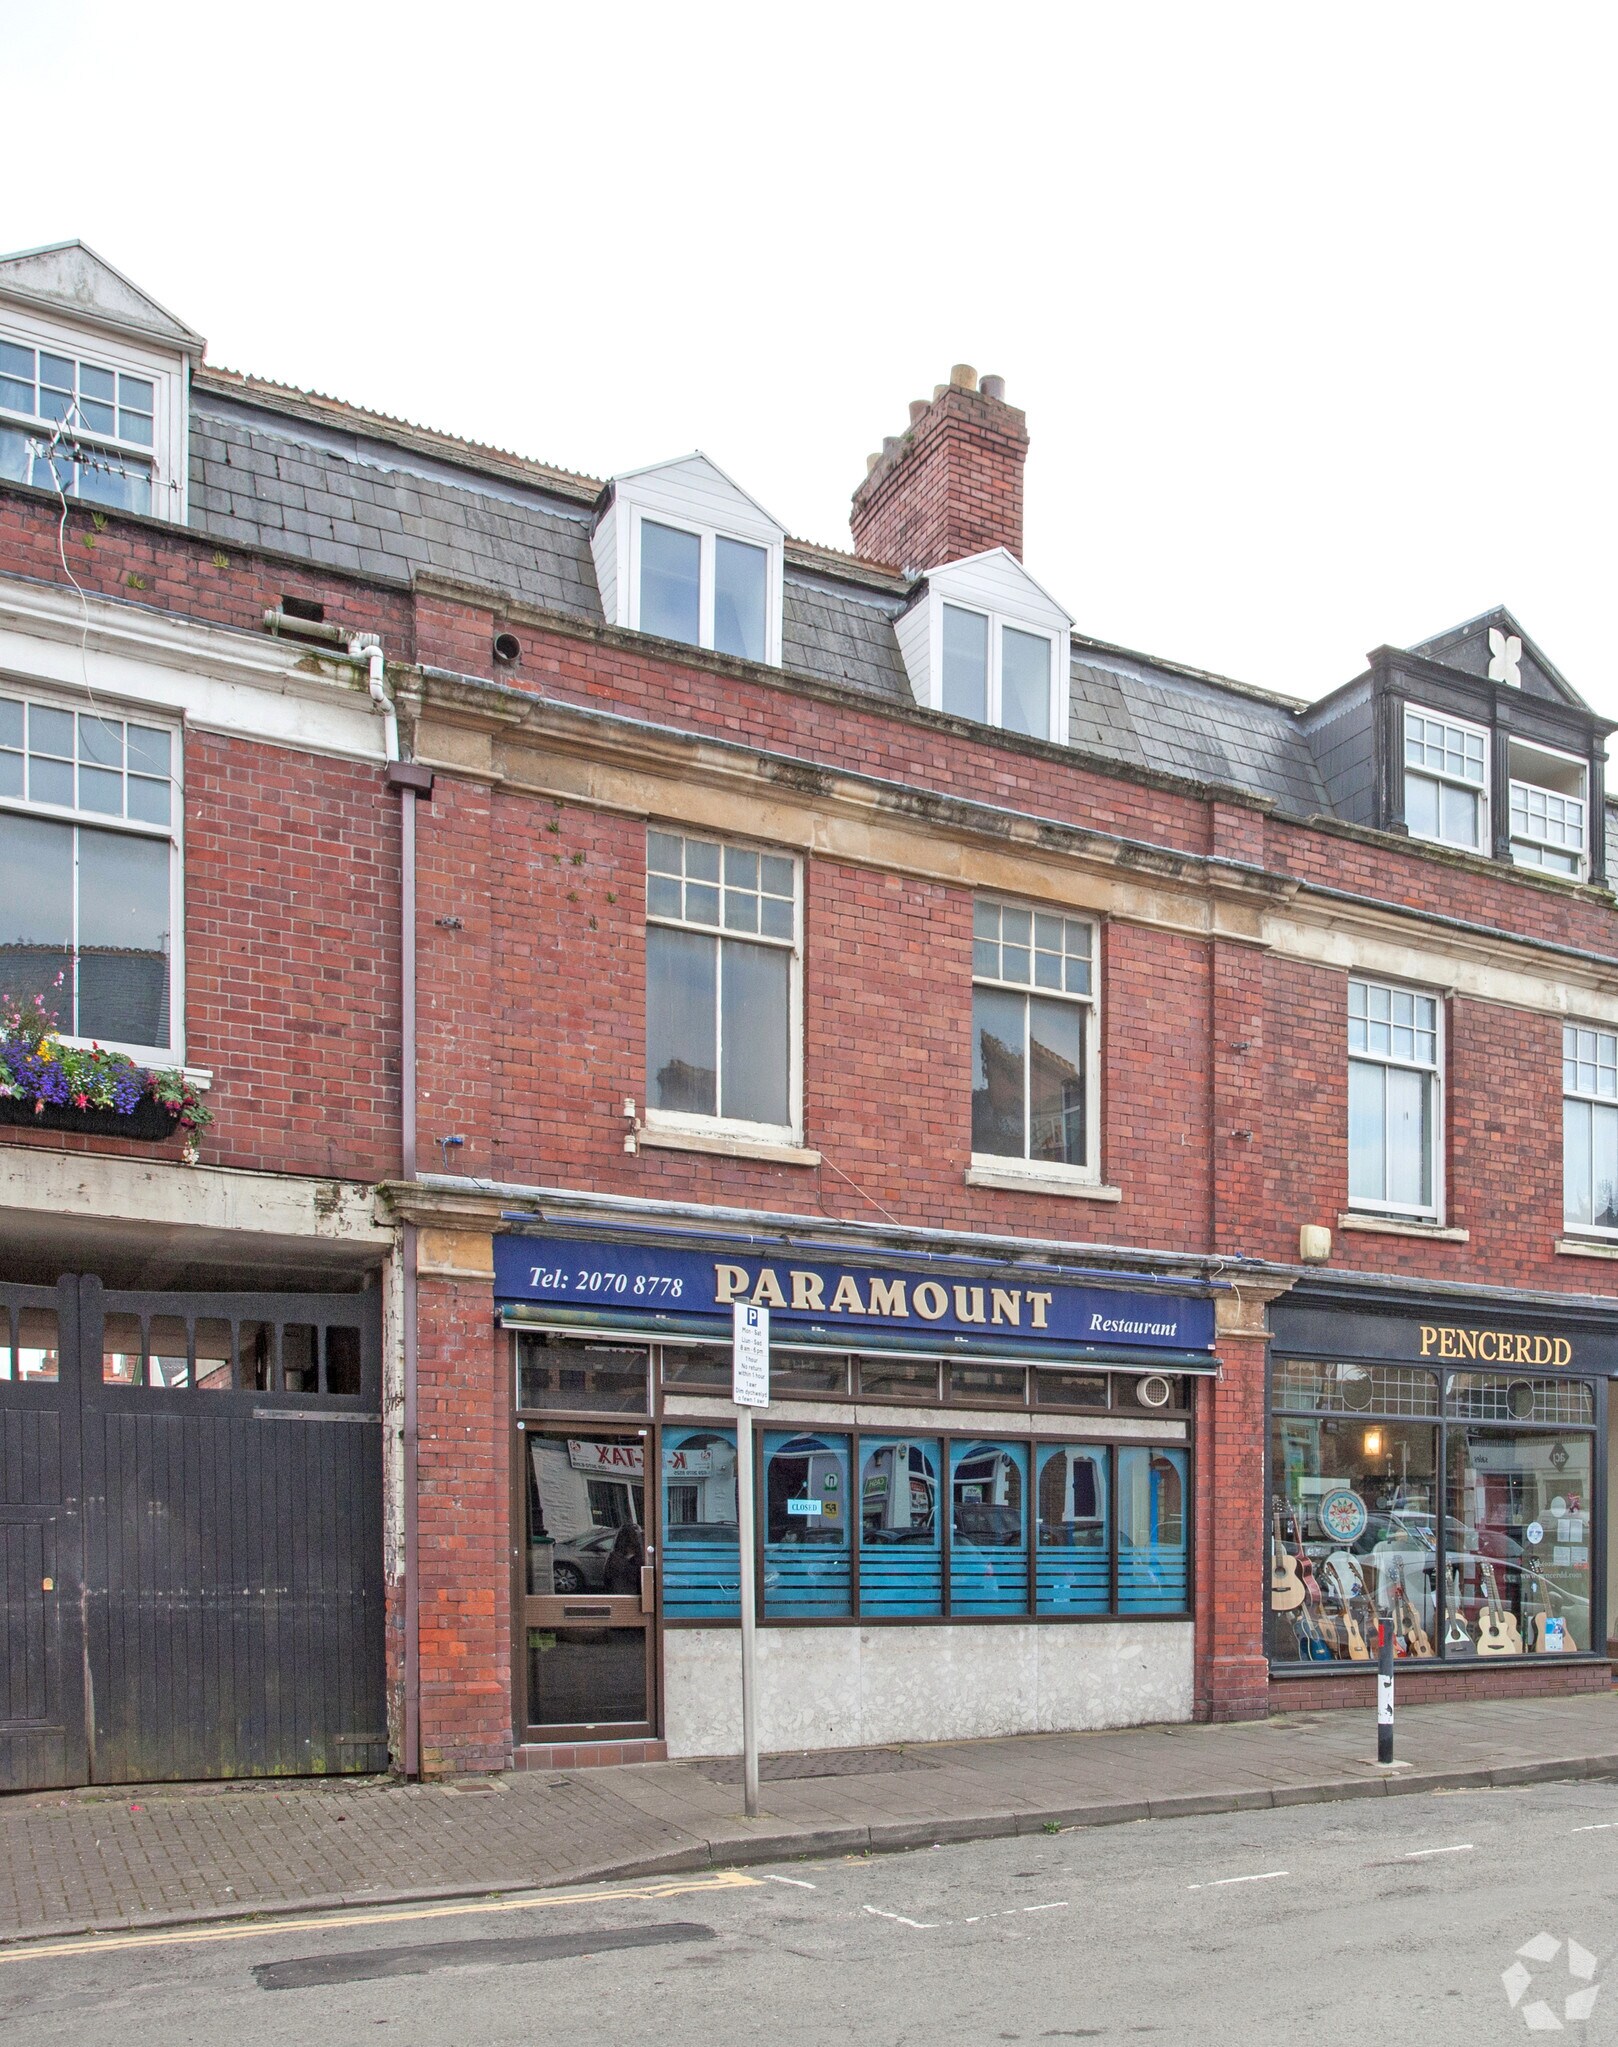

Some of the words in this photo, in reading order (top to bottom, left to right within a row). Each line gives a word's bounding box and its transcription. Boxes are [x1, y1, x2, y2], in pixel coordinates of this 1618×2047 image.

[530, 1267, 569, 1289] Tel:
[575, 1270, 628, 1293] 2070
[633, 1275, 684, 1298] 8778
[714, 1263, 1053, 1328] PARAMOUNT
[1089, 1313, 1178, 1337] Restaurant
[1419, 1326, 1572, 1366] PENCERDD
[791, 1503, 818, 1511] CLOSED
